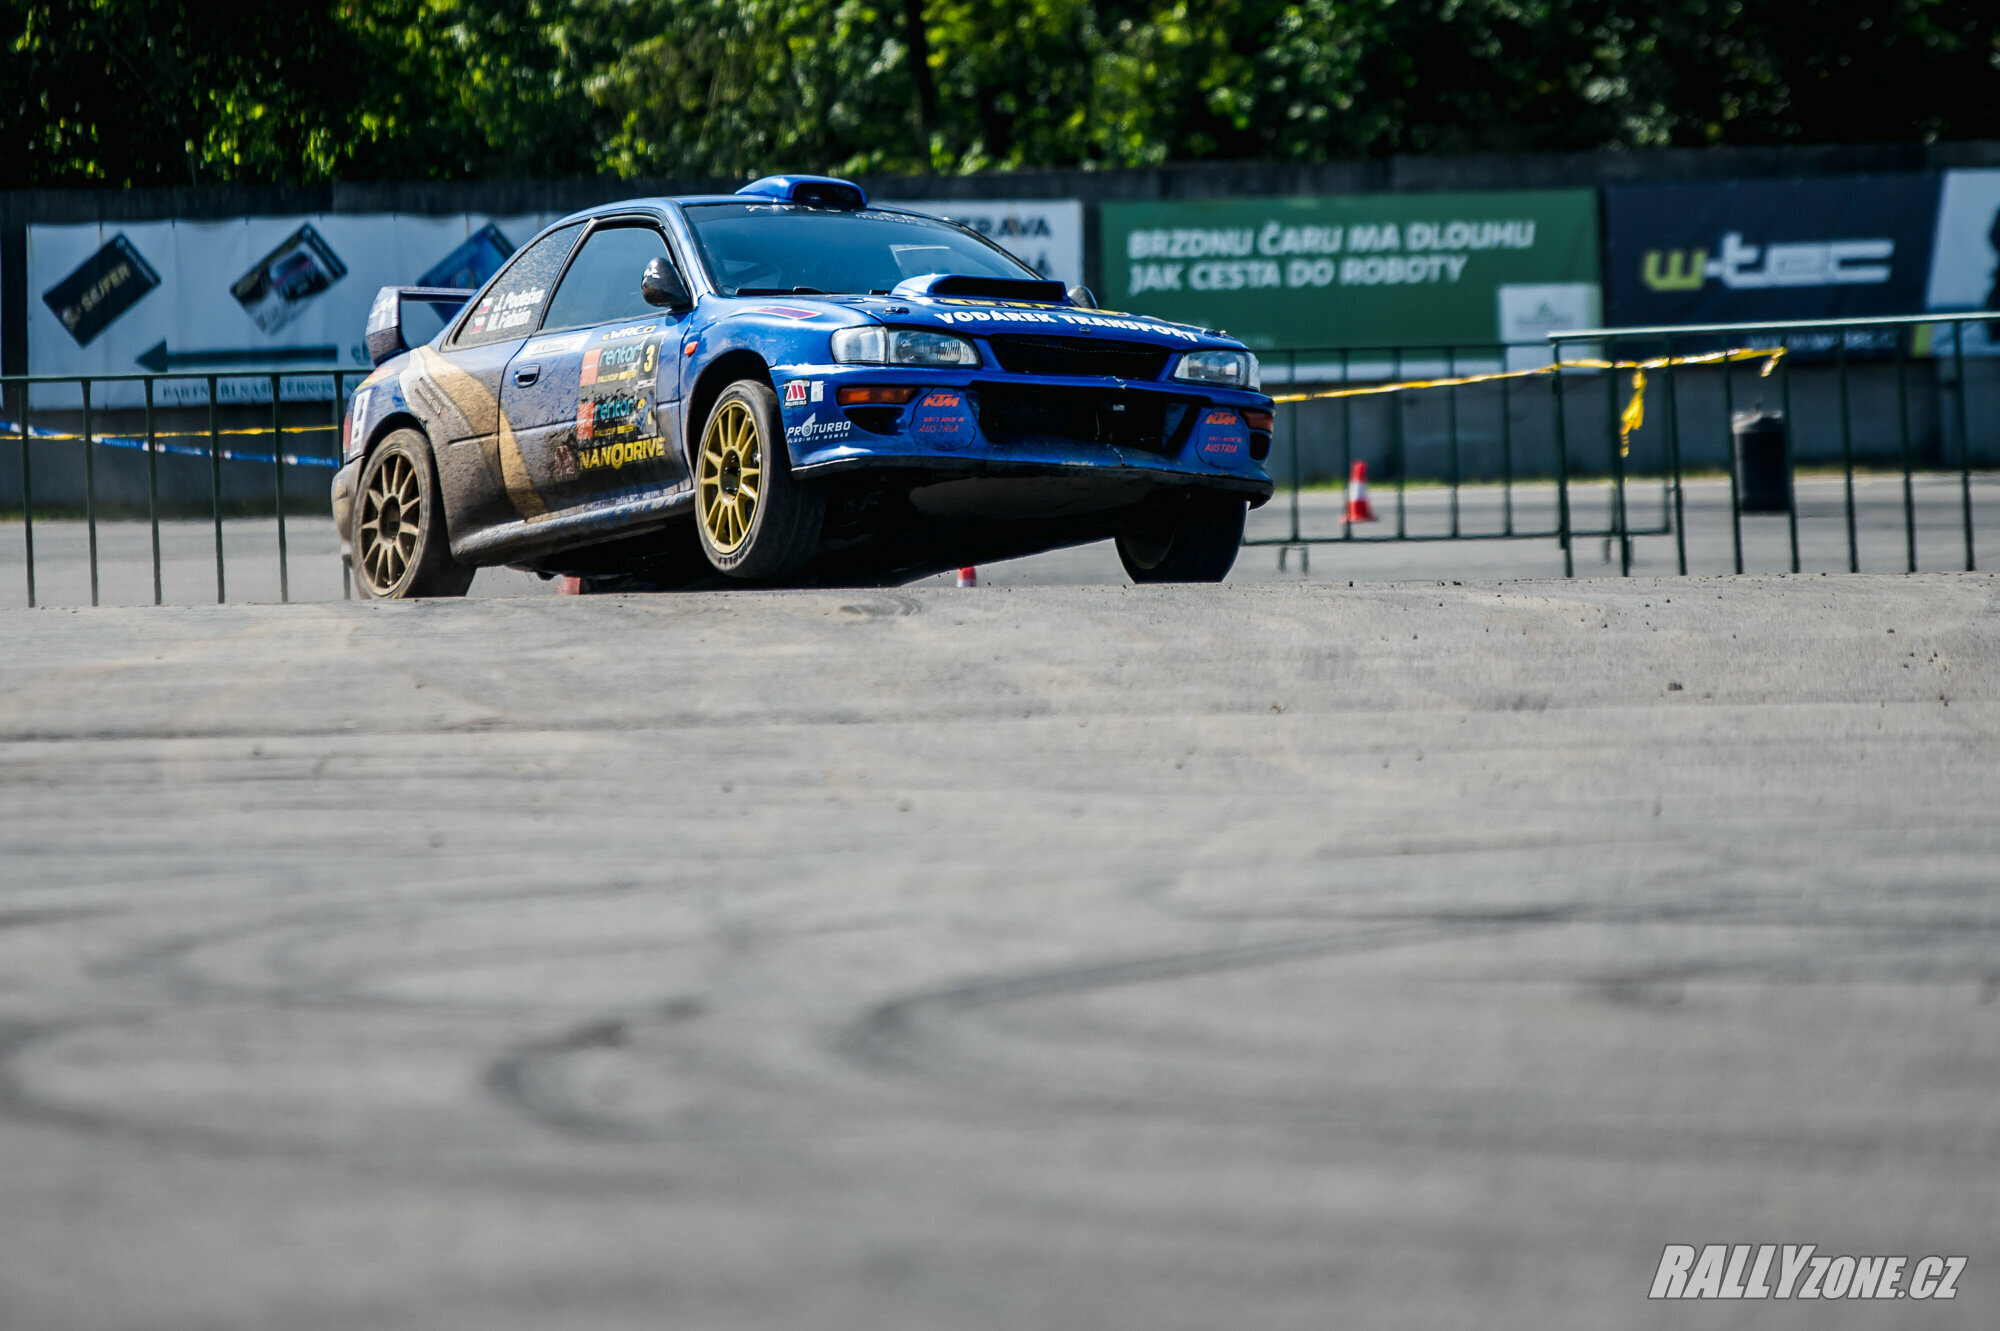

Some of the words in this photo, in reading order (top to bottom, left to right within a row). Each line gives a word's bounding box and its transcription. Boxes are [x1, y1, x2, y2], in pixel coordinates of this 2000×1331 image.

[1127, 228, 1254, 259] BRZDNU
[1257, 221, 1343, 255] ČARU
[1348, 223, 1400, 253] MA
[1405, 219, 1536, 250] DLOUHU
[1643, 231, 1894, 291] w-tec
[1128, 263, 1184, 297] JAK
[1188, 260, 1281, 290] CESTA
[1287, 257, 1335, 287] DO
[1340, 254, 1469, 285] ROBOTY
[934, 310, 1058, 325] VODÁREK
[1058, 314, 1199, 343] TRANSPORT
[599, 344, 640, 367] rentor
[643, 344, 656, 373] 3
[594, 398, 635, 420] rentor
[922, 394, 960, 407] KTM
[787, 413, 851, 437] PROTURBO
[918, 424, 959, 433] AUSTRIA
[1205, 412, 1237, 425] KTM
[579, 437, 665, 470] NANODRIVE
[1204, 443, 1238, 453] AUSTRIA
